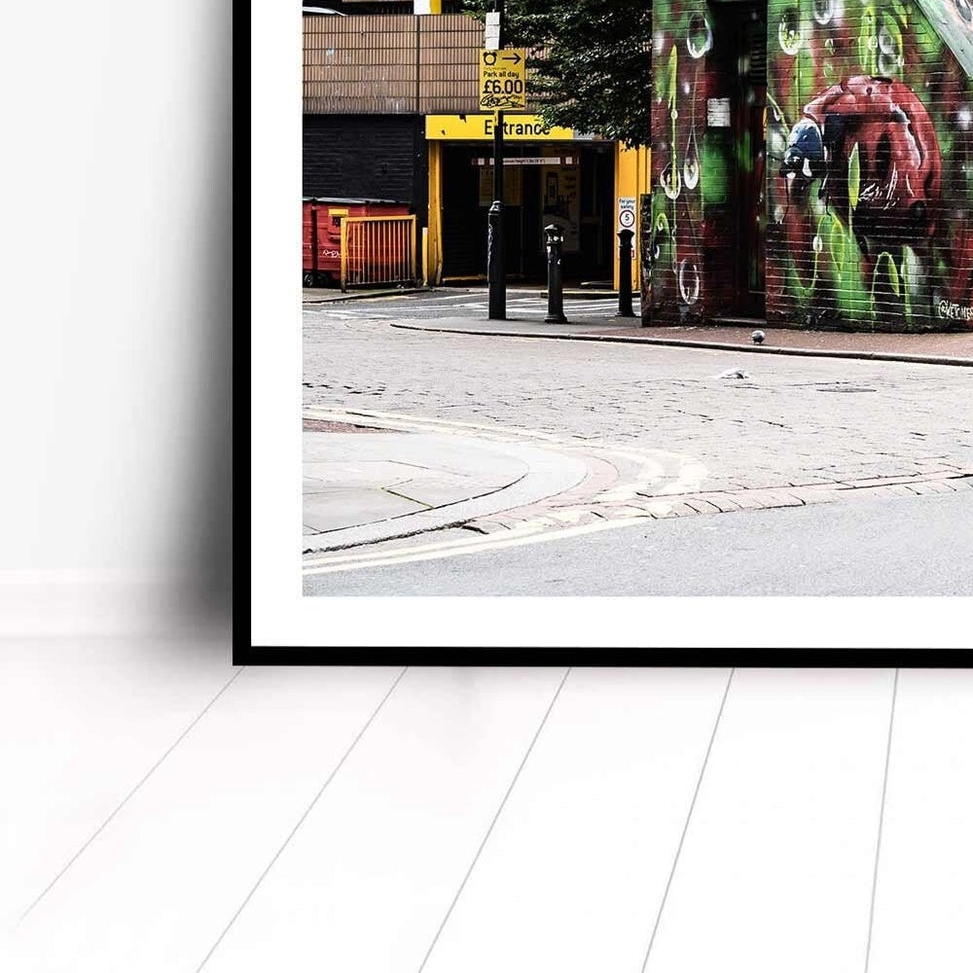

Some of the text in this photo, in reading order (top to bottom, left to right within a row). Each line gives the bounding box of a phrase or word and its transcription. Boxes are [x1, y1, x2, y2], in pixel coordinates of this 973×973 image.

[507, 71, 520, 79] day
[482, 79, 523, 94] £6.00
[484, 119, 550, 135] Etrance
[624, 213, 630, 221] 5
